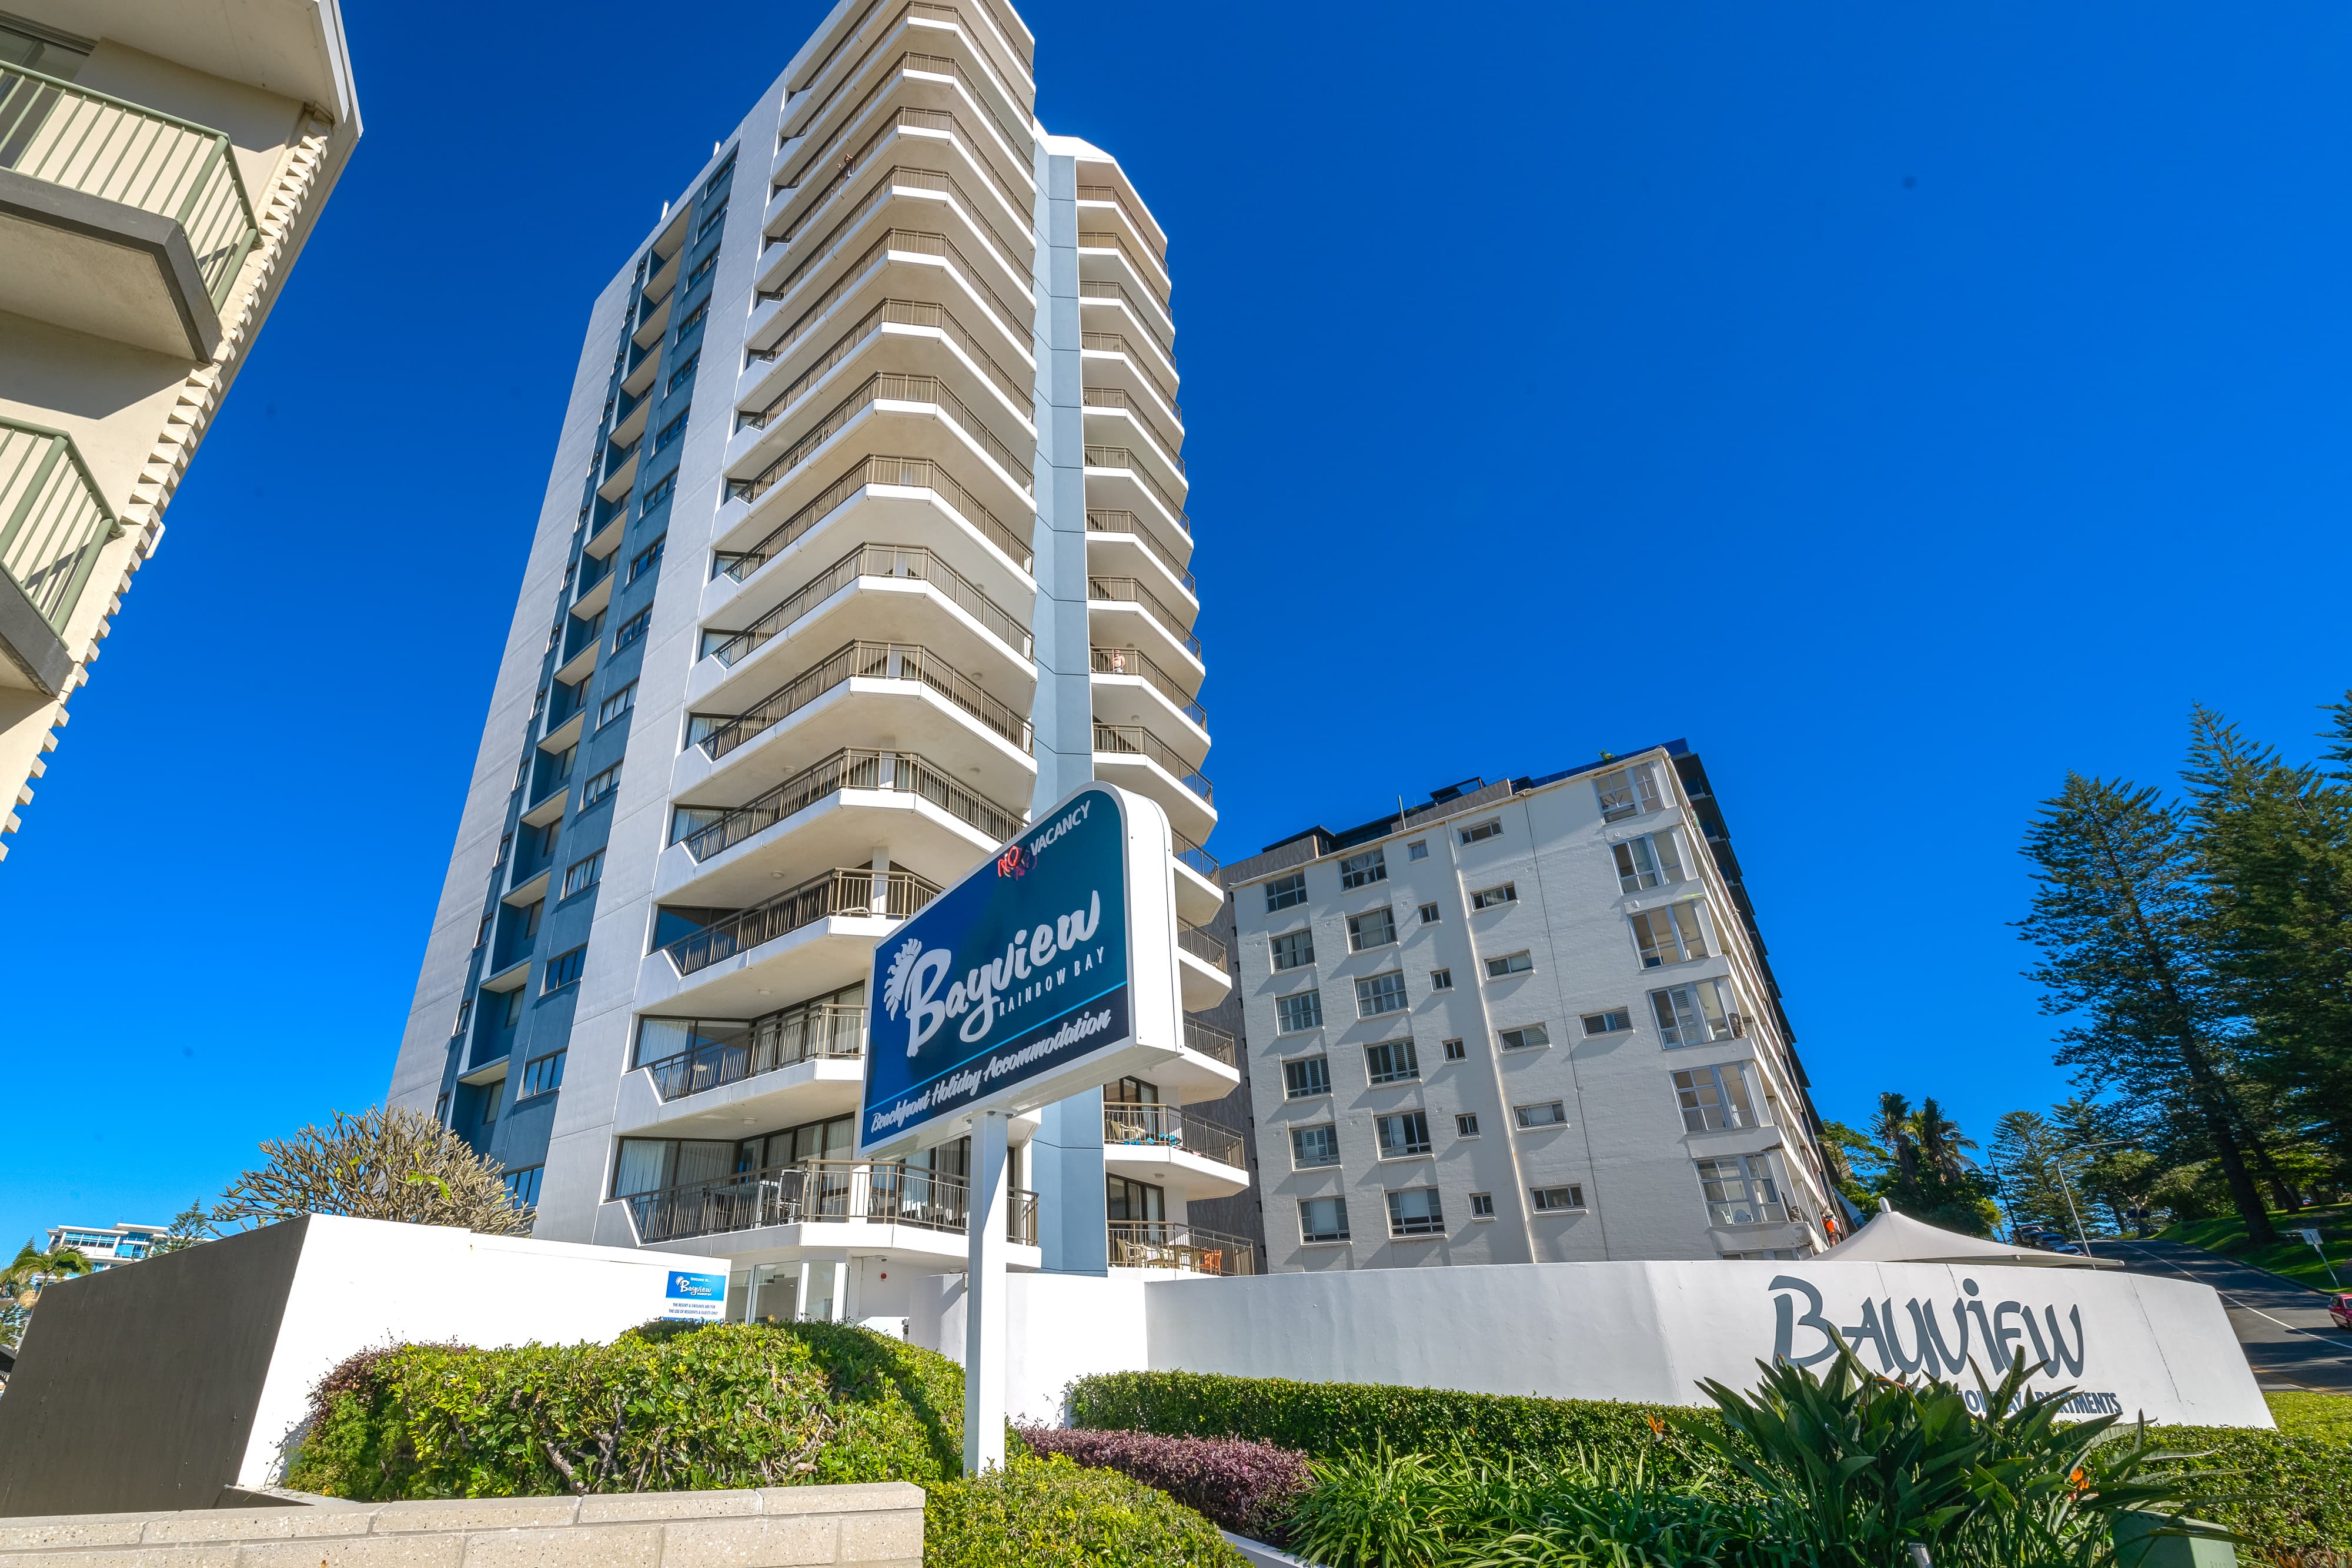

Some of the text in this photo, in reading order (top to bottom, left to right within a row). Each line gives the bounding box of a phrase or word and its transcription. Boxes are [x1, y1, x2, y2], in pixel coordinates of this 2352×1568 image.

[1030, 800, 1090, 856] VACANCY
[904, 890, 1101, 1057] Bayview
[1000, 947, 1104, 1017] RAINBOW BAY
[871, 1009, 1111, 1133] Beachfront Holiday Accommodation
[680, 1279, 712, 1296] Bayview
